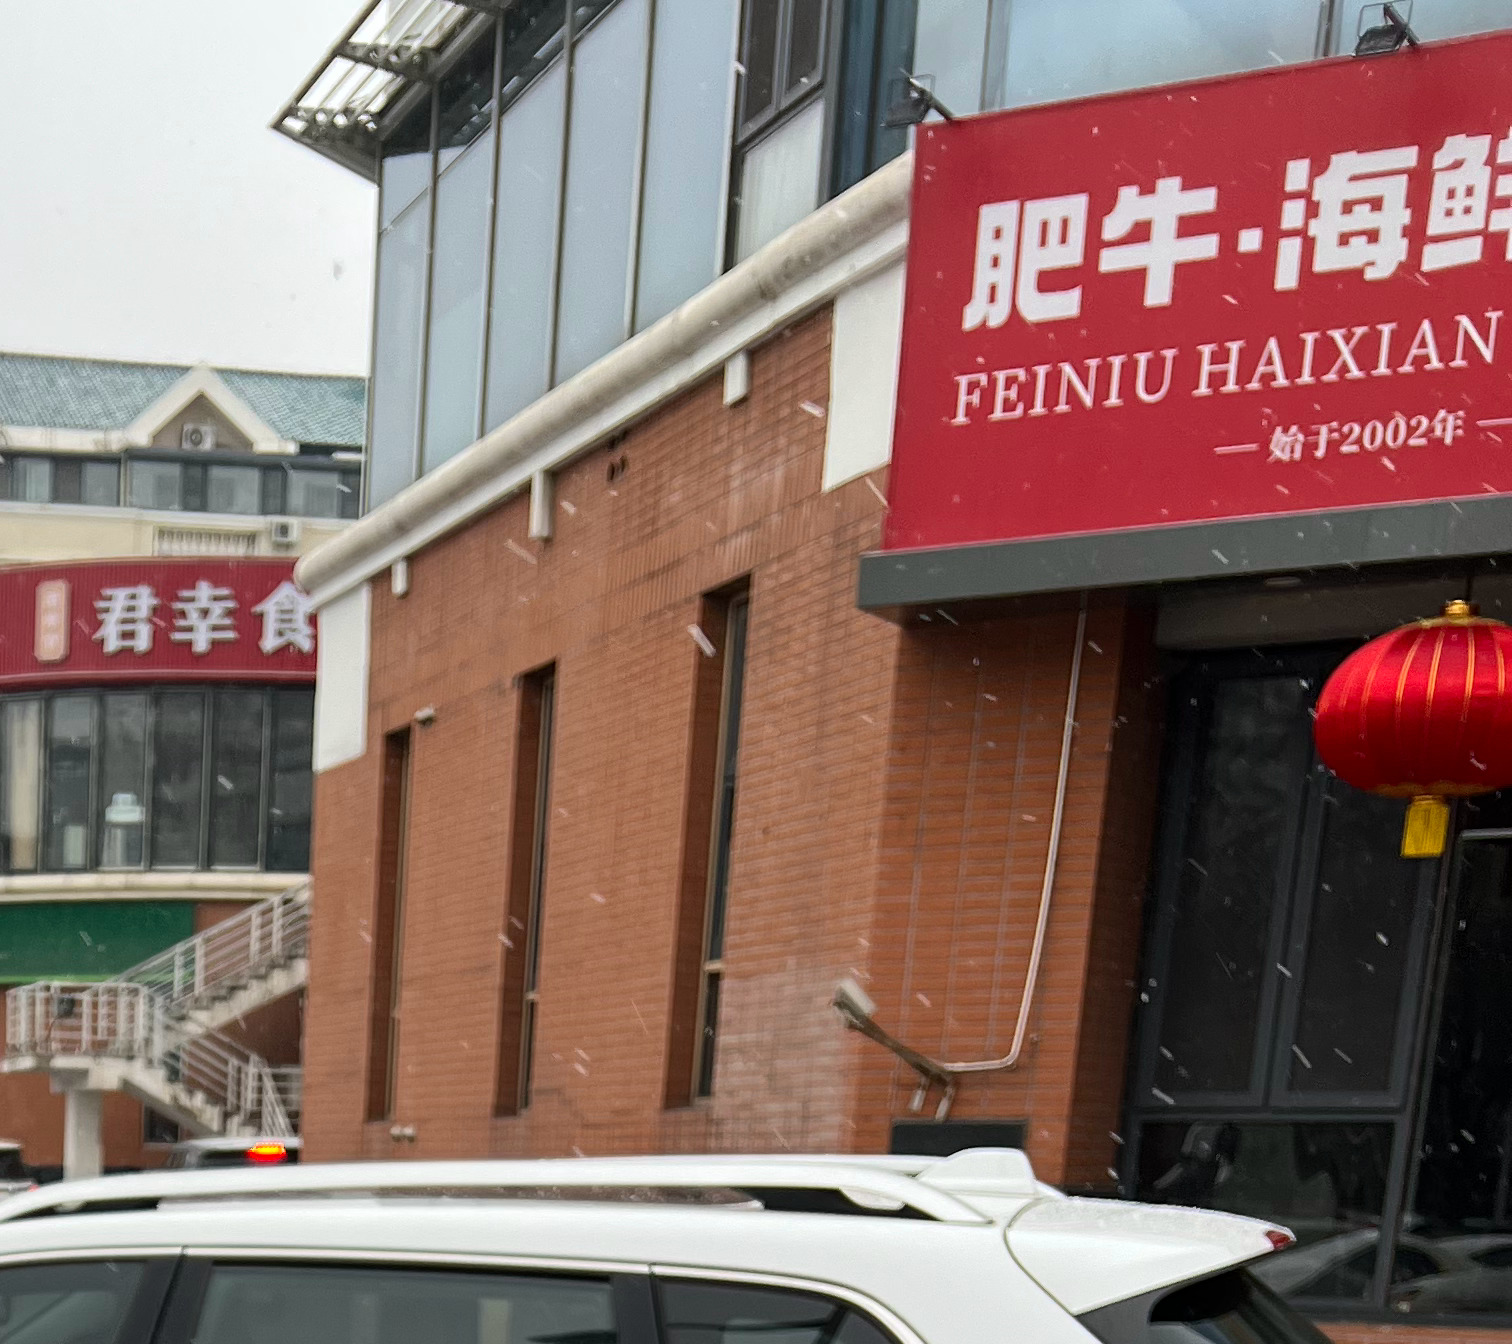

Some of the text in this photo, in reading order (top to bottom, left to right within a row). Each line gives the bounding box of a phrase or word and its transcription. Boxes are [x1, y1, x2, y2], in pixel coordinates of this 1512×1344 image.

[961, 126, 1512, 333] 肥牛·海鲜
[951, 310, 1504, 427] FEINIU HAIXIAN
[1266, 408, 1466, 463] 始于2002年
[90, 579, 317, 656] 君幸食
